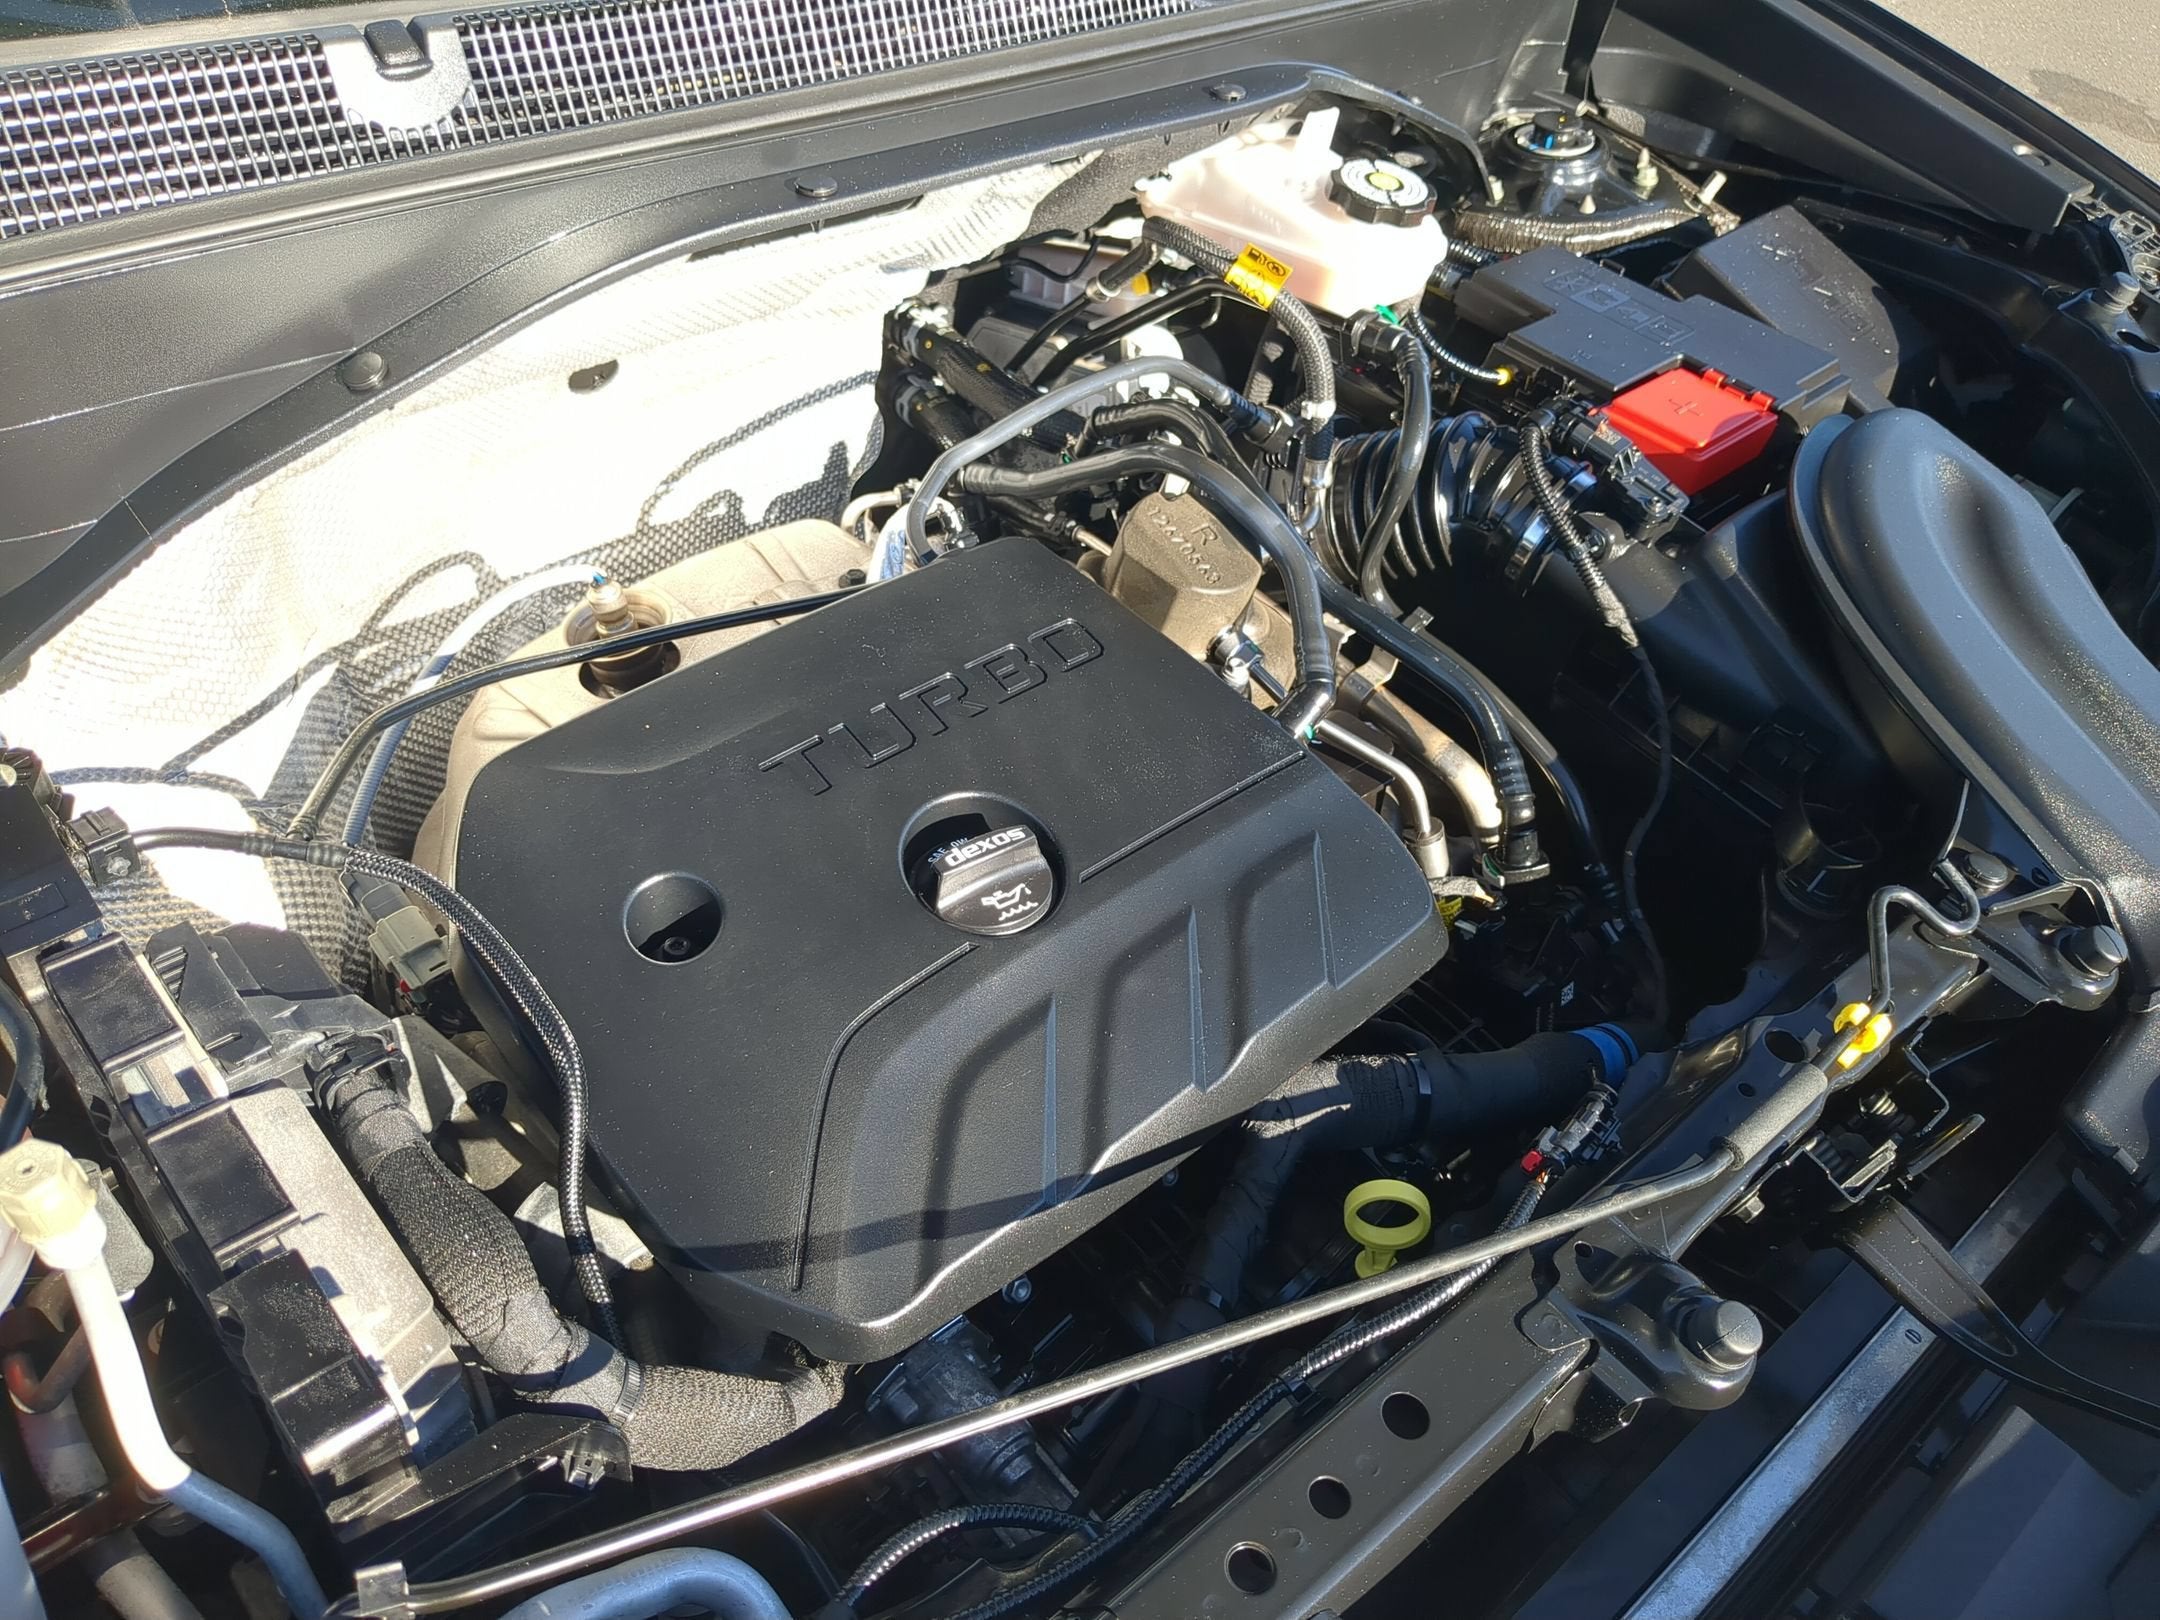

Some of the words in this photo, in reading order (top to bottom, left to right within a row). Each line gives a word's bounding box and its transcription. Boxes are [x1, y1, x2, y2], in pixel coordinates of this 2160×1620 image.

[1191, 522, 1218, 546] R
[758, 617, 1104, 796] TURBO
[944, 827, 1026, 867] dexos
